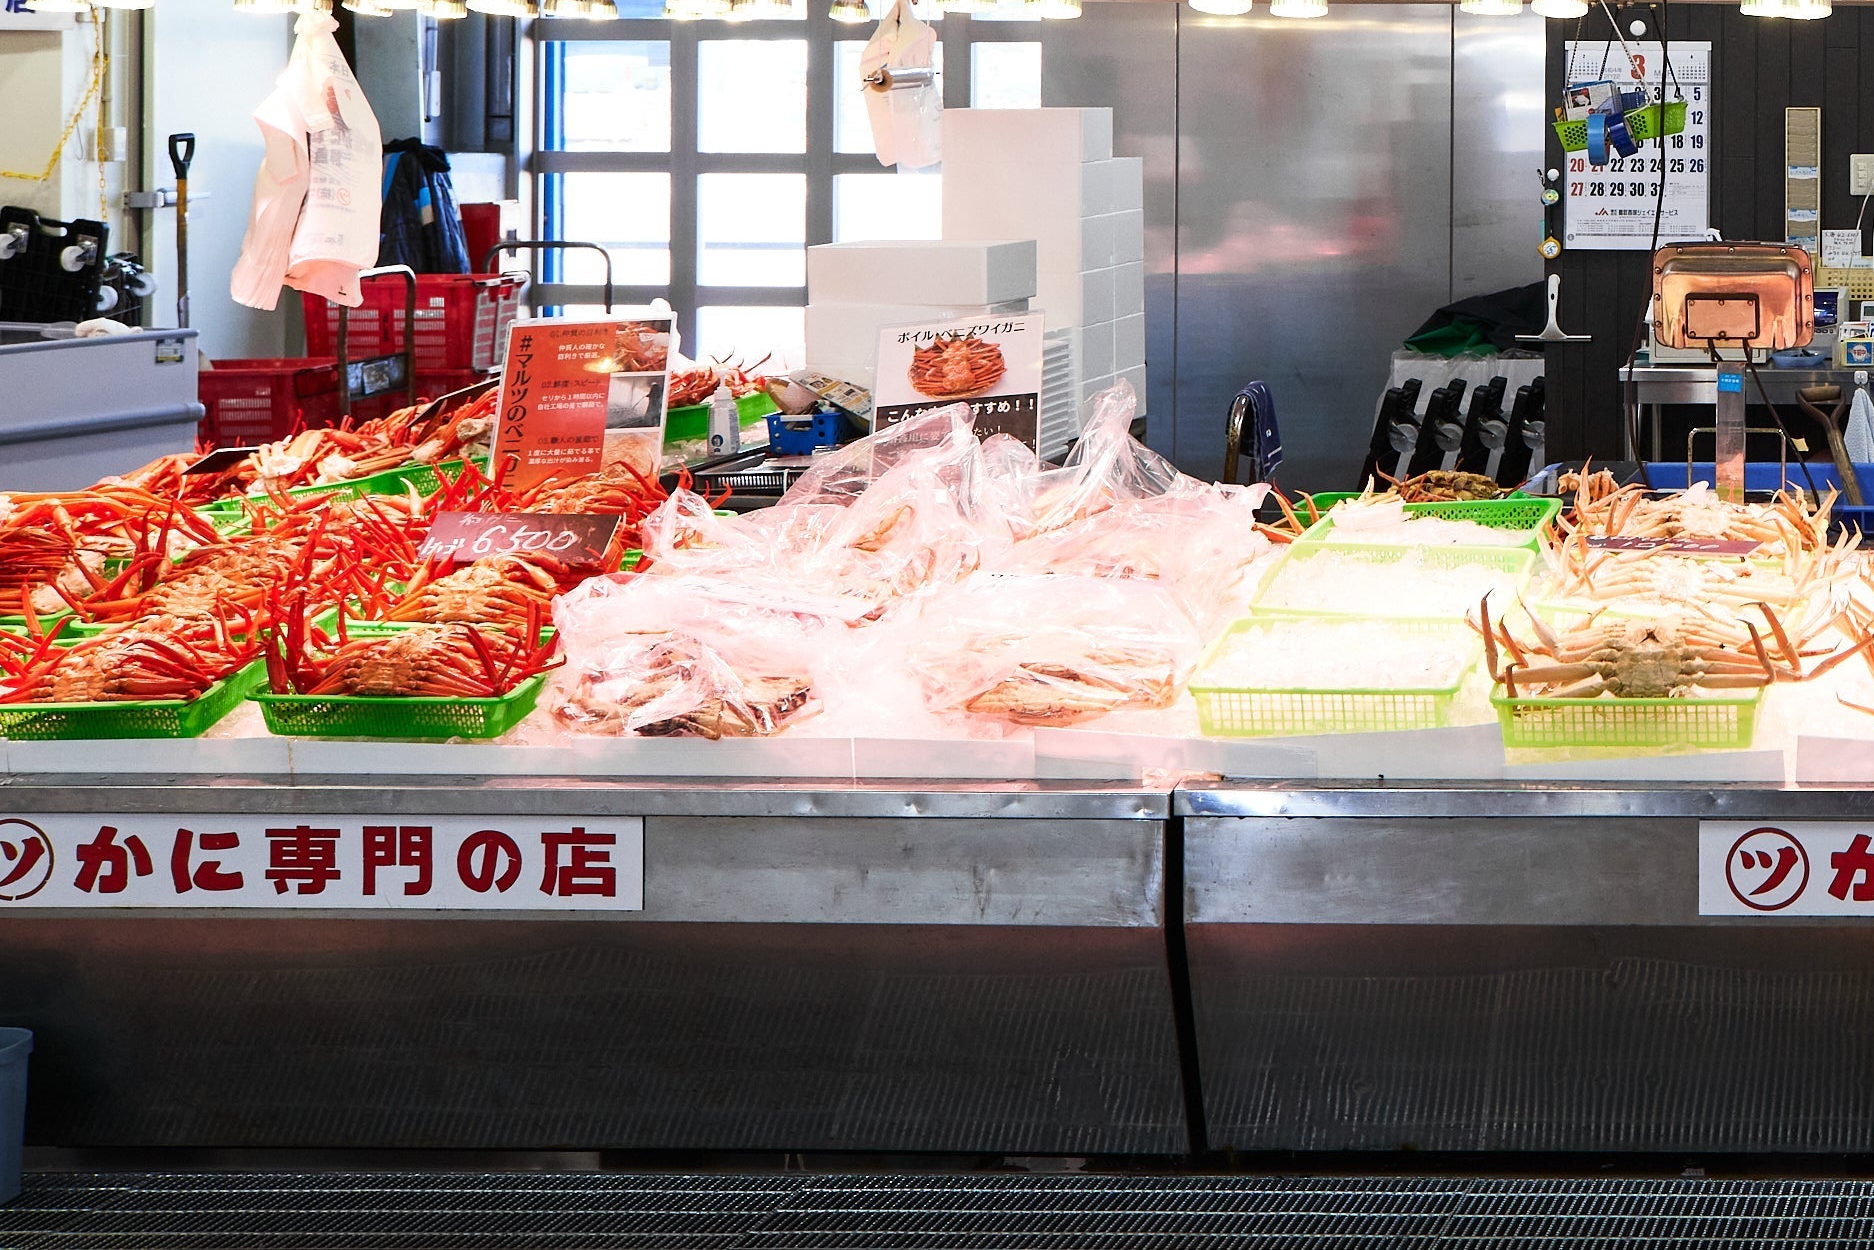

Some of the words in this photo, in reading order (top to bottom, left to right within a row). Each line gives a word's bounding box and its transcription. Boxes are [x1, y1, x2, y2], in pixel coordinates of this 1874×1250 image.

[1630, 54, 1646, 80] 3
[1693, 86, 1701, 101] 5
[1691, 110, 1704, 125] 12
[1671, 134, 1684, 149] 18
[1690, 134, 1704, 149] 19
[1570, 158, 1585, 173] 20
[1610, 158, 1624, 173] 22
[1630, 158, 1645, 173] 23
[1669, 158, 1685, 173] 25
[1689, 158, 1704, 173] 26
[1570, 182, 1584, 197] 27
[1589, 182, 1605, 197] 28
[1609, 182, 1625, 197] 29
[1629, 182, 1645, 197] 30
[471, 524, 578, 554] 6500
[73, 824, 617, 898] かに専門の店
